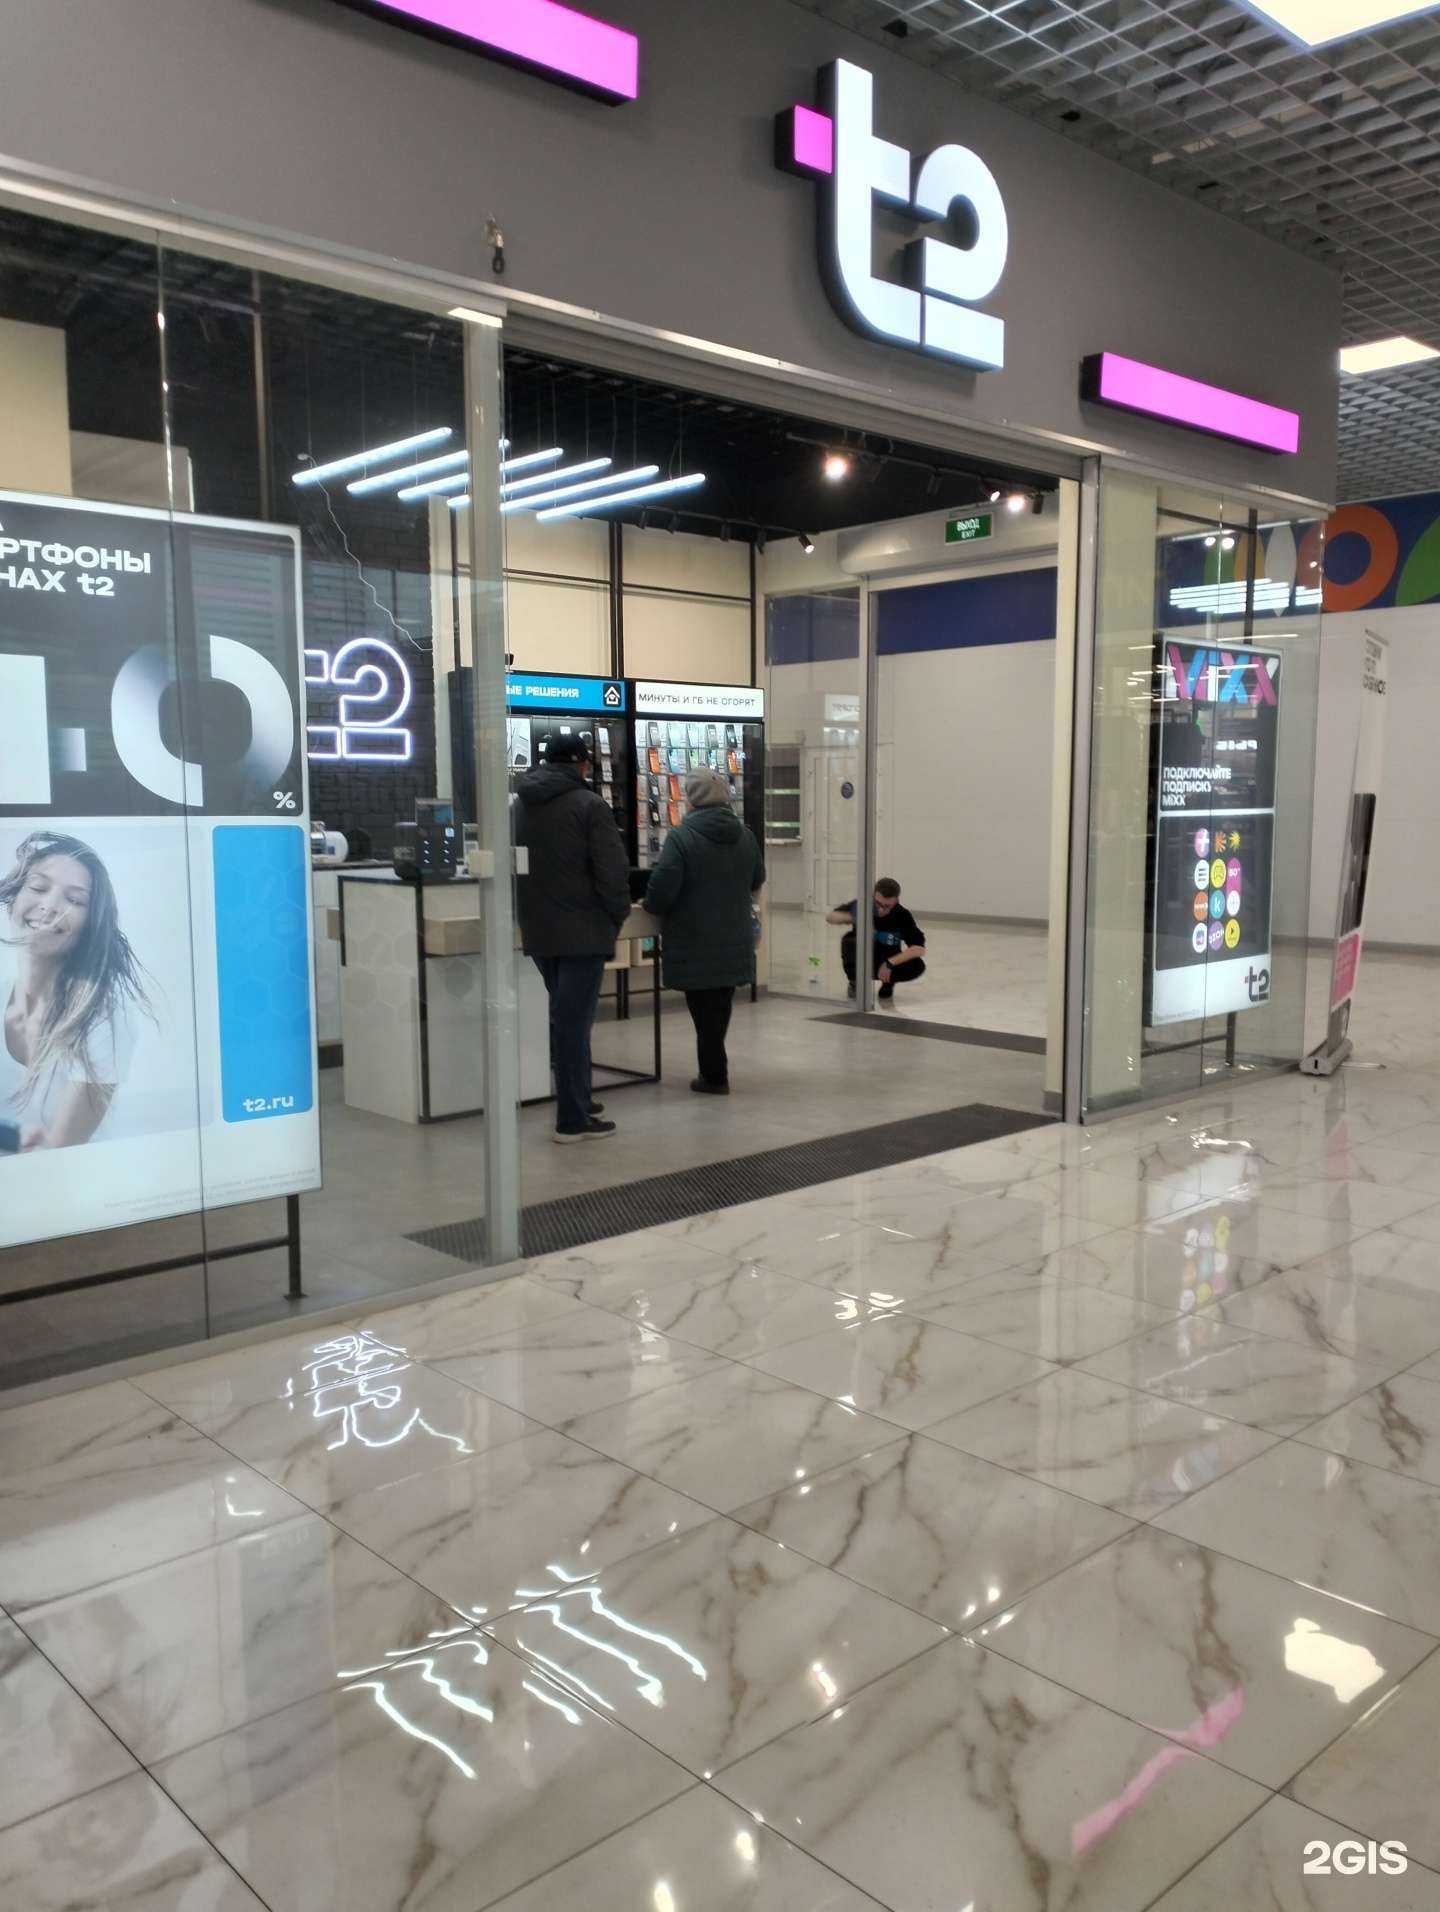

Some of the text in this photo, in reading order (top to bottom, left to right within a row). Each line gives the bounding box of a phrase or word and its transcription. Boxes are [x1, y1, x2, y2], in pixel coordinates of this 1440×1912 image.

[794, 58, 1008, 370] t2
[77, 573, 115, 597] t2
[526, 685, 580, 699] РЕШЕНИЯ
[639, 693, 756, 706] МИНУТЫ И ГБ НЕ ОГОРЯТ
[1162, 764, 1232, 781] ПОДКЛЮЧАЙТЕ
[1245, 966, 1270, 1002] t2
[242, 1095, 294, 1113] t2.ru
